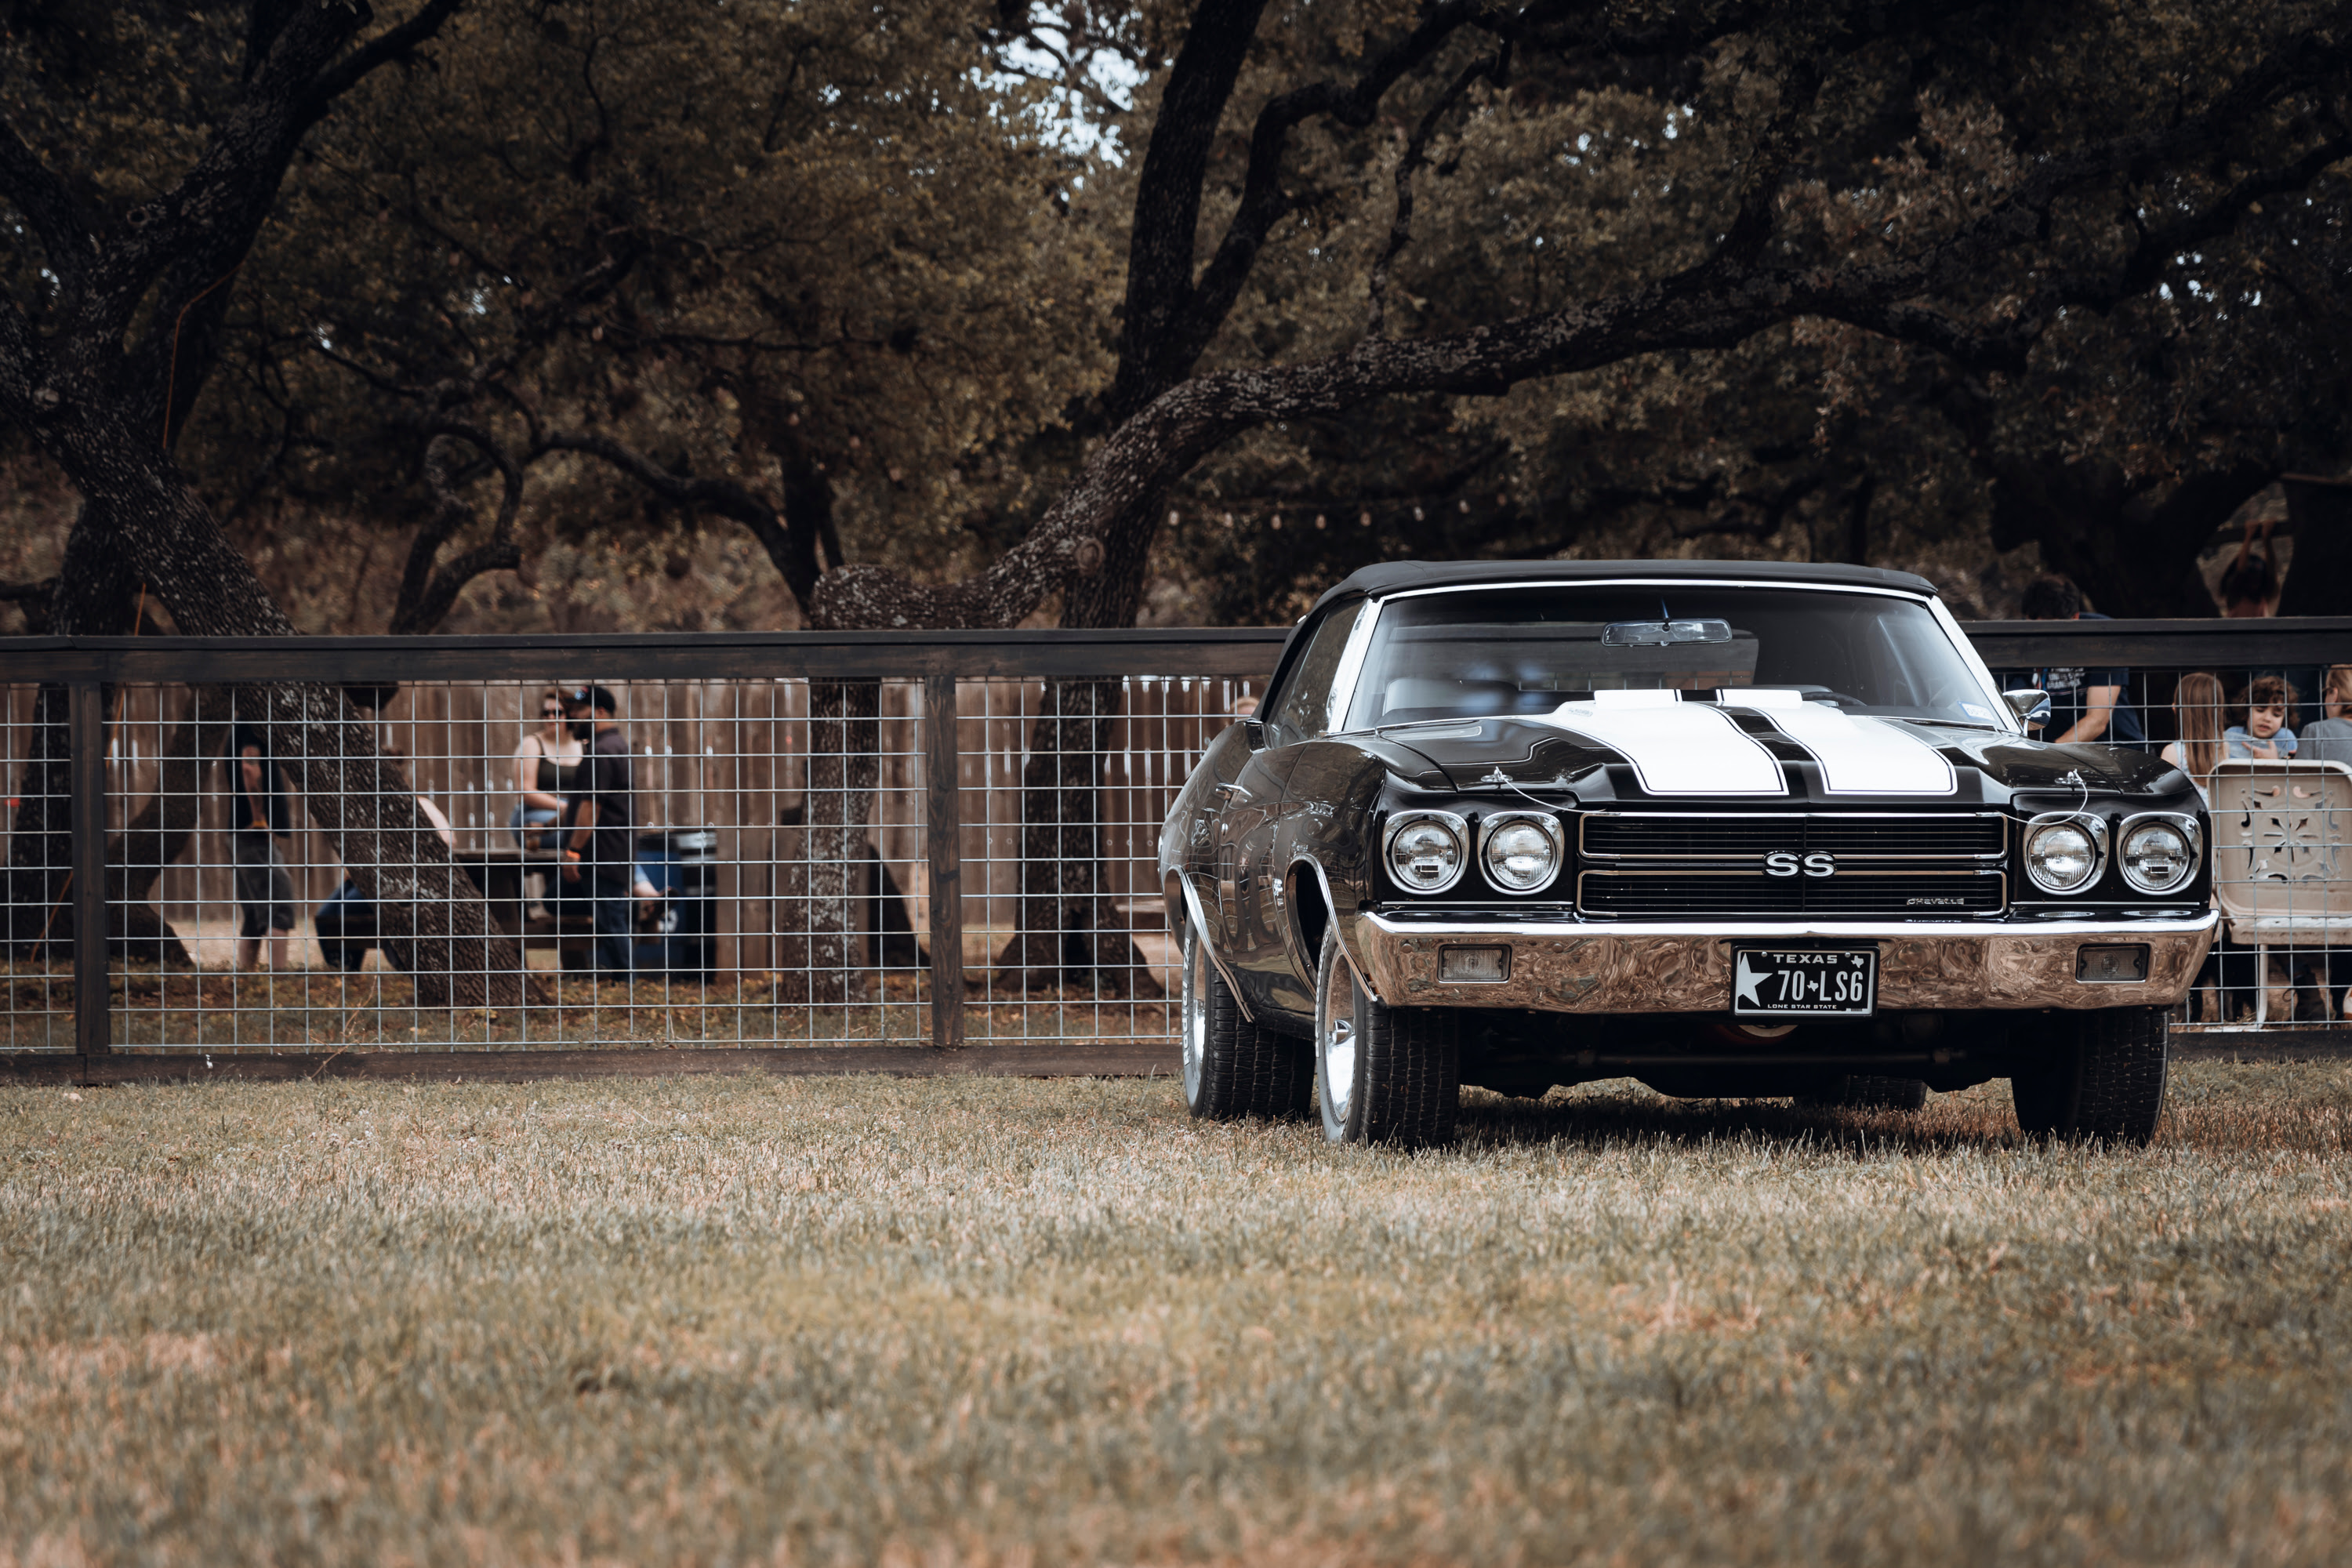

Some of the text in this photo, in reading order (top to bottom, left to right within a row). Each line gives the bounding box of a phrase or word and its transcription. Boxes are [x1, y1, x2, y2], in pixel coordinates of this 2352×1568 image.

[1766, 852, 1835, 877] SS
[1773, 954, 1838, 964] TEXAS
[1181, 981, 1190, 1066] Radial
